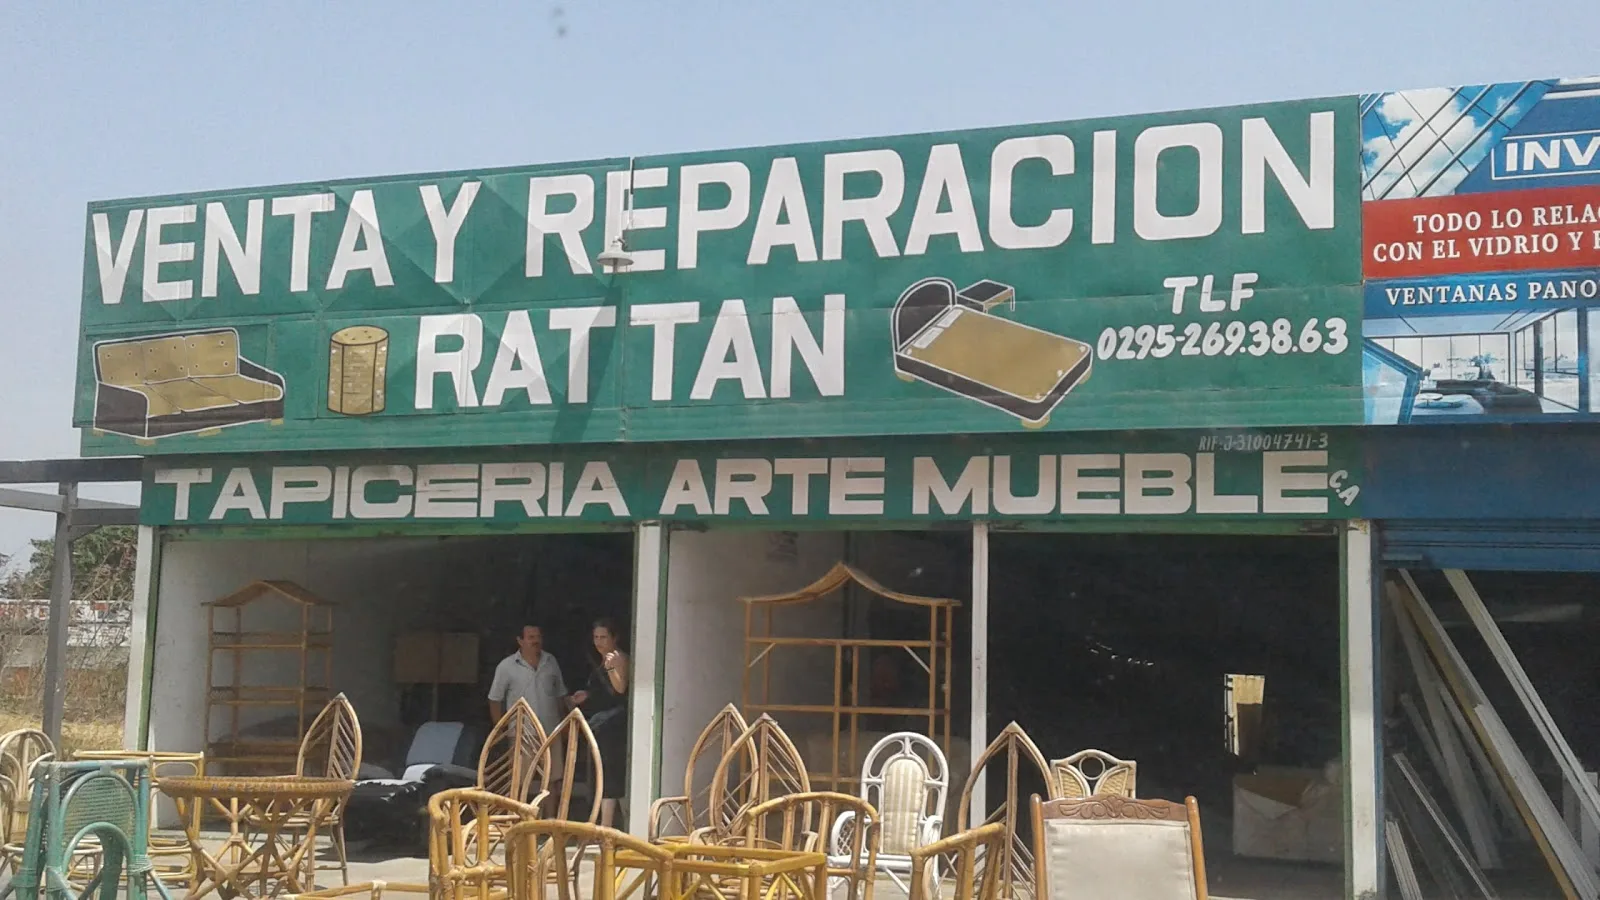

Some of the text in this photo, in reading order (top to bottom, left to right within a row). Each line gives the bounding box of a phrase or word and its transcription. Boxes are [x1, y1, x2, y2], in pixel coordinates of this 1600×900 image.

[93, 111, 1335, 304] VENTA Y REPARACION
[1413, 203, 1600, 234] TODO LO RELA
[1373, 241, 1423, 262] CON
[1432, 239, 1460, 259] EL
[1468, 233, 1559, 256] VIDRIO
[1567, 231, 1584, 251] Y
[1163, 273, 1259, 314] TLF
[1385, 279, 1600, 306] VENTANAS PANO
[415, 294, 846, 409] RATTAN
[1097, 317, 1349, 360] 0295-269.38.63
[153, 461, 630, 520] TAPICERIA
[659, 457, 885, 515] ARTE
[912, 450, 1329, 516] MUEBLE
